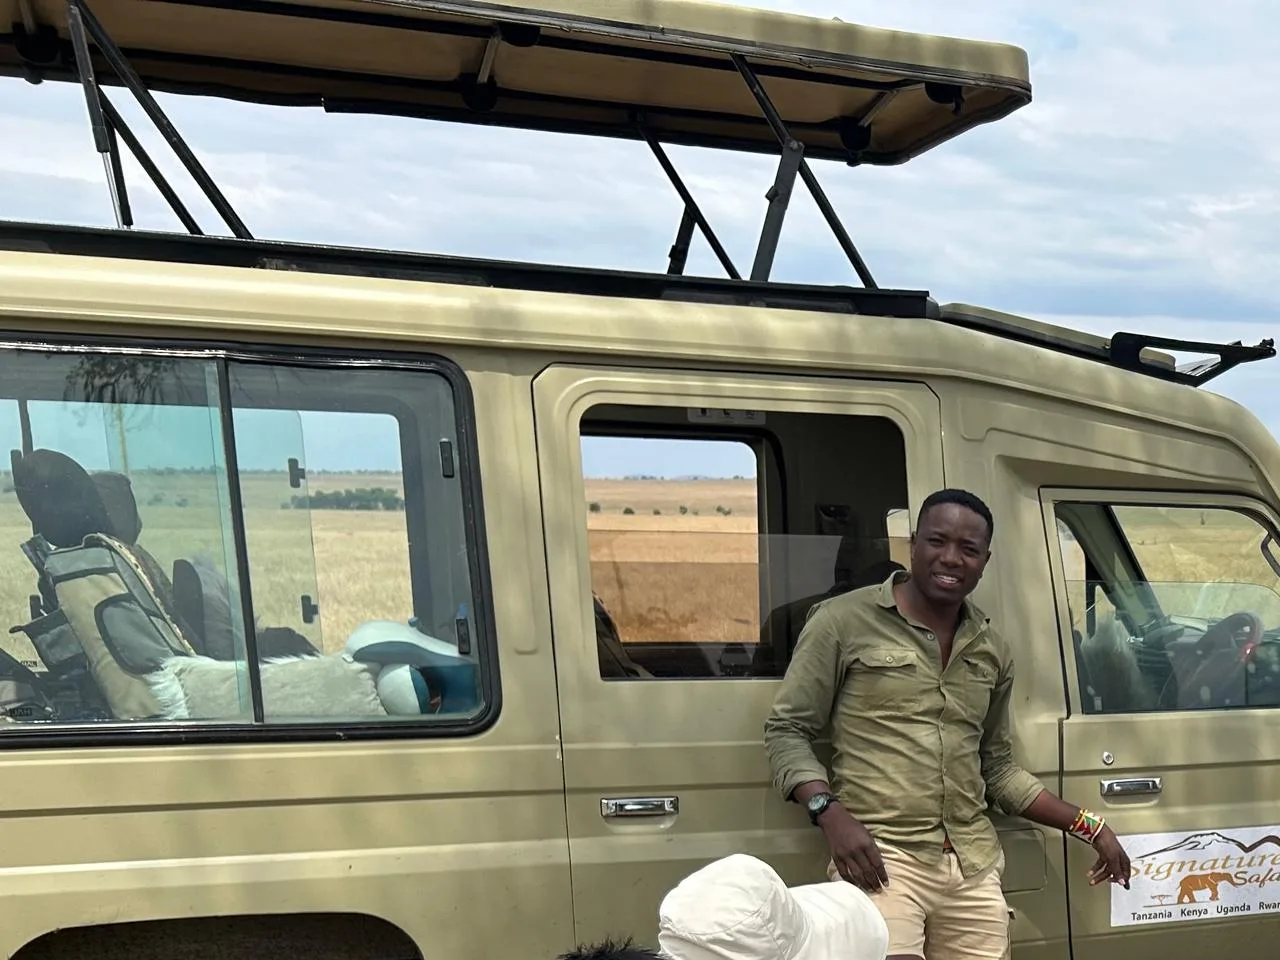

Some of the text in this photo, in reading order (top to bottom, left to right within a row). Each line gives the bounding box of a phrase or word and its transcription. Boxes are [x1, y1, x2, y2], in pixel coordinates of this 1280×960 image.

[1131, 909, 1173, 921] Tanzania
[1180, 907, 1209, 918] Kenya
[1216, 902, 1251, 916] Uganda
